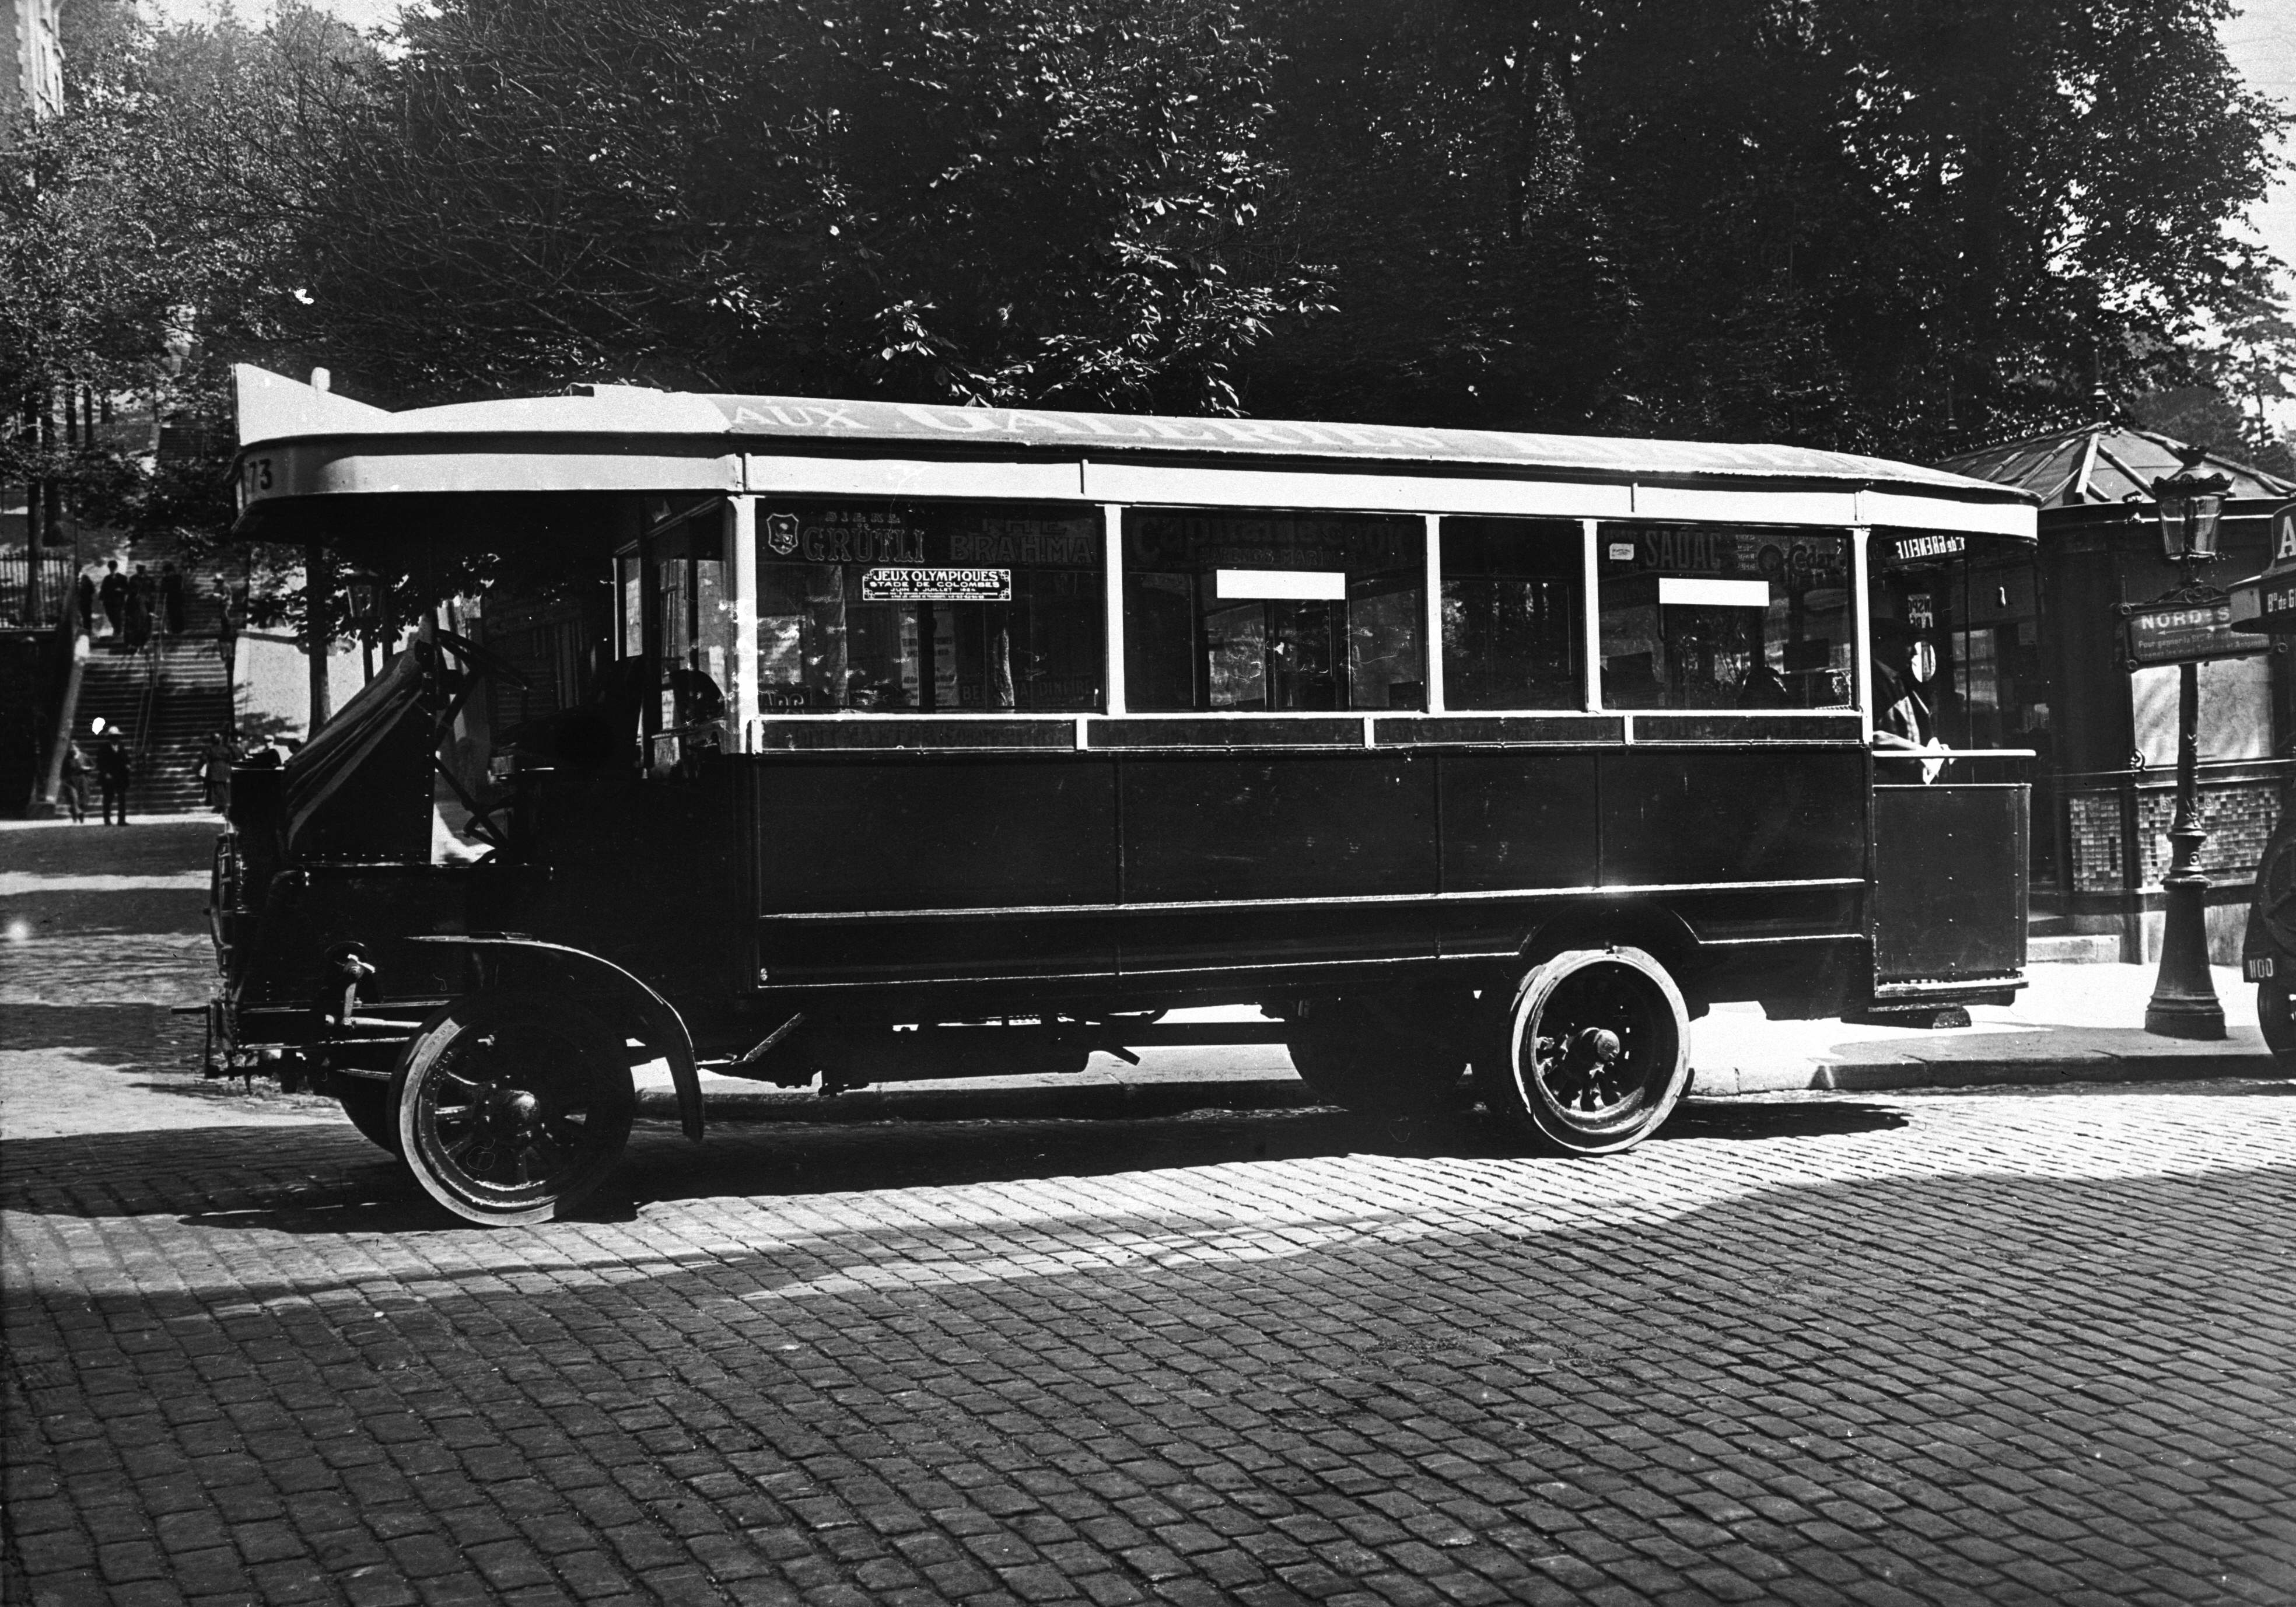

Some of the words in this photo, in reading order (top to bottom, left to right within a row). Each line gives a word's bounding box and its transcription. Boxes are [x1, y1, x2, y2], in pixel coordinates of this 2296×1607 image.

[733, 405, 870, 430] AUX
[896, 404, 1444, 447] GALERIES
[802, 523, 925, 563] GRÜTLI
[950, 534, 1093, 563] BRAHMA
[873, 570, 909, 582] JEUX
[911, 570, 998, 582] OLYMPIQUES
